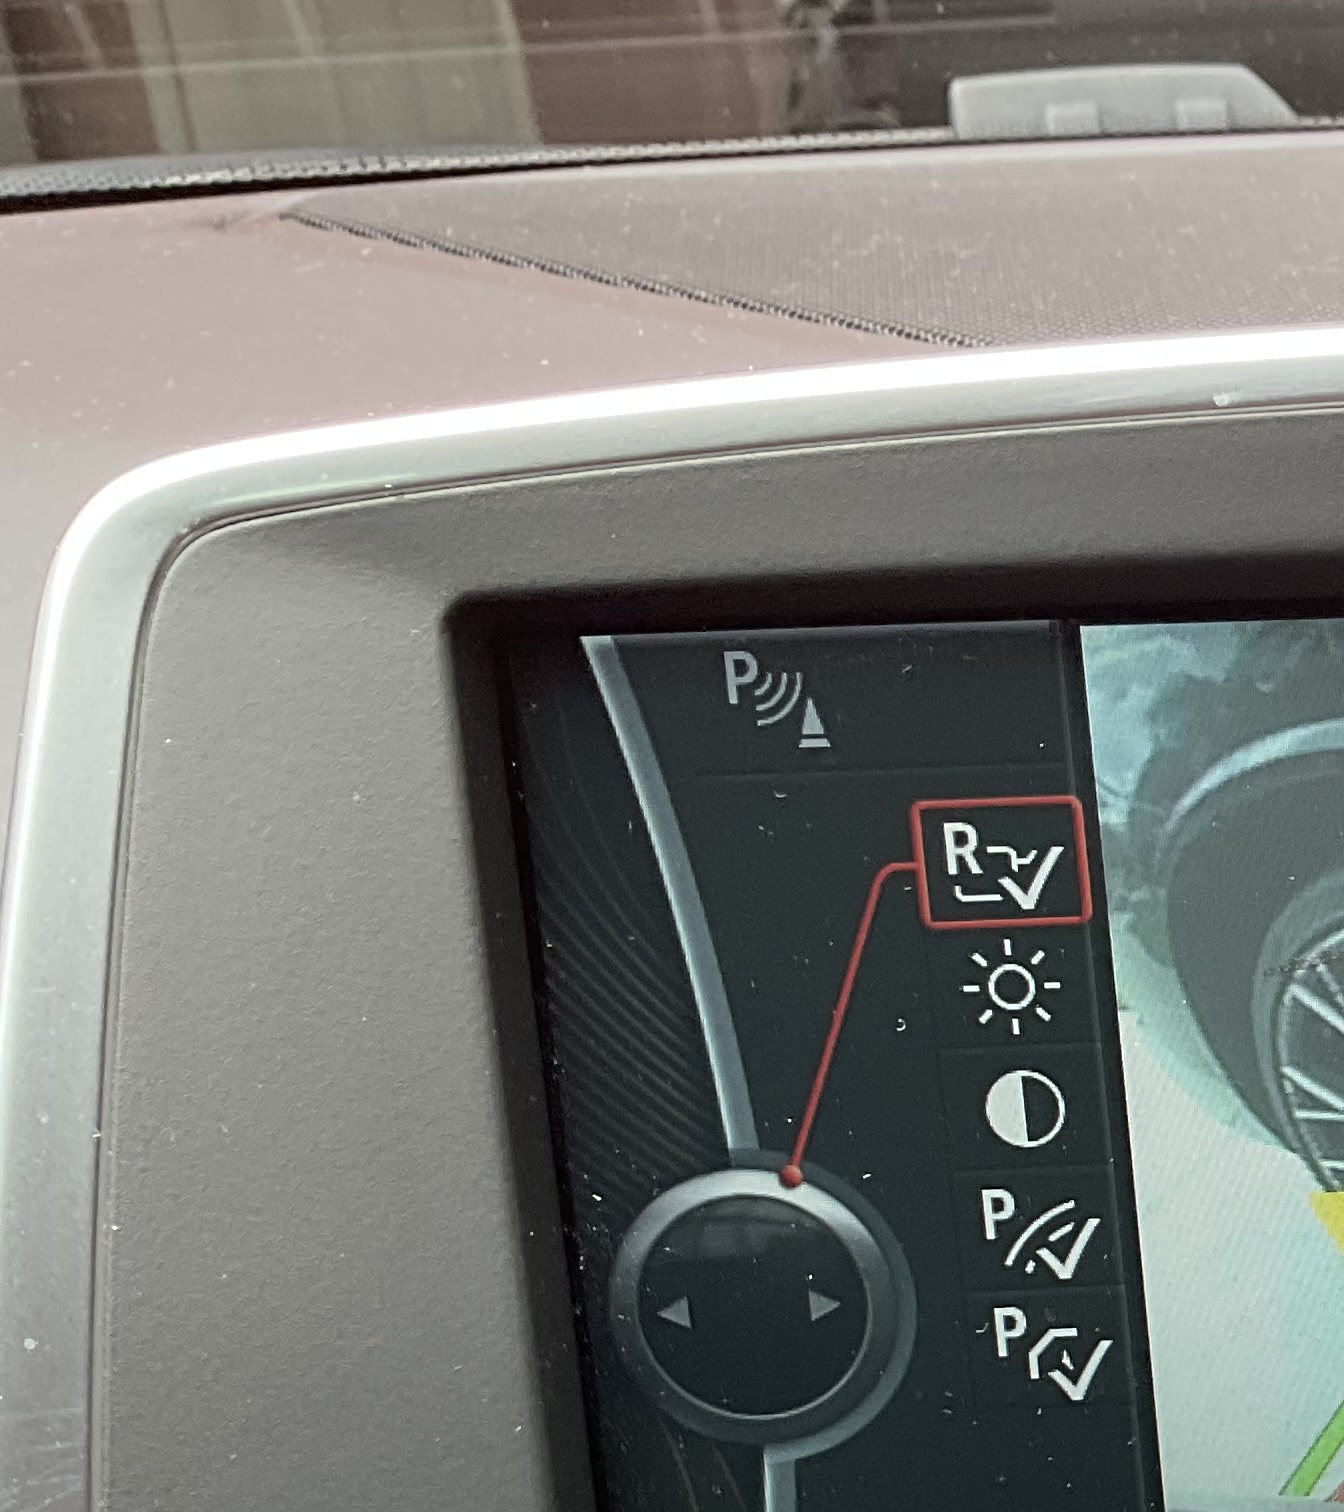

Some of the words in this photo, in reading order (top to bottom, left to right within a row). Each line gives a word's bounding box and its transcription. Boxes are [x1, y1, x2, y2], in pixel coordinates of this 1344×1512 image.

[723, 651, 758, 704] P
[943, 822, 982, 876] R
[981, 1189, 1015, 1240] P
[993, 1307, 1027, 1357] P
